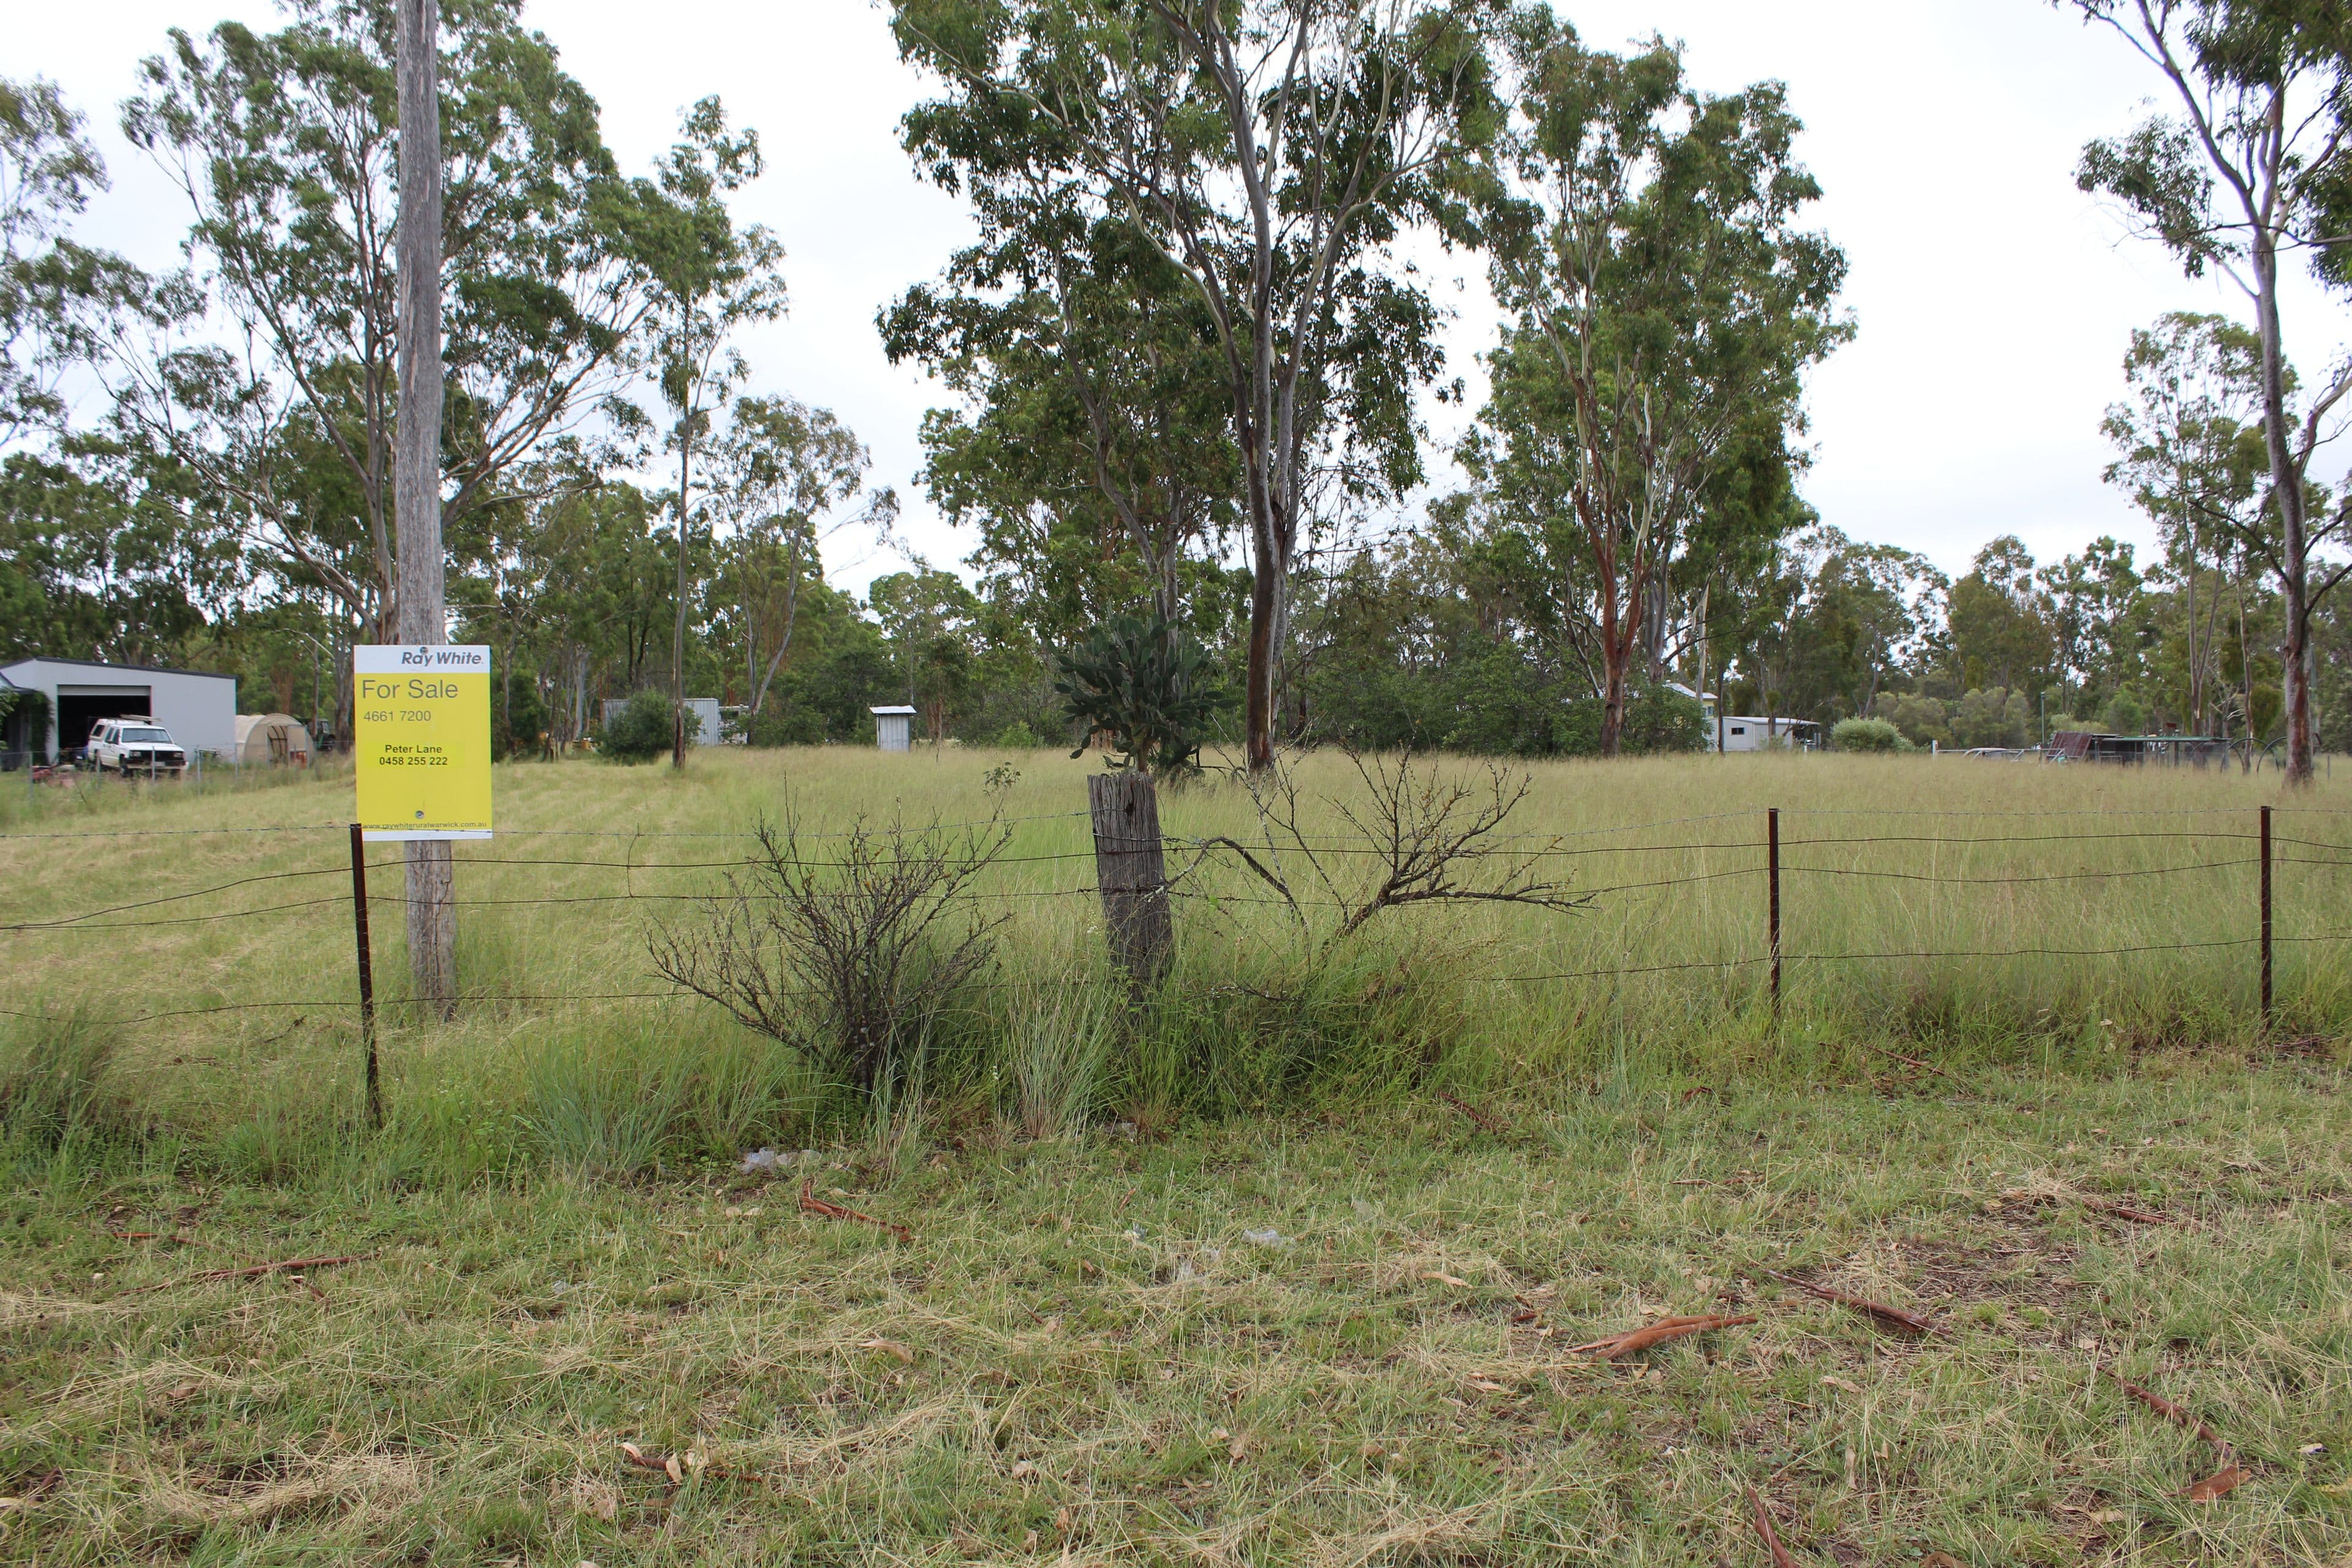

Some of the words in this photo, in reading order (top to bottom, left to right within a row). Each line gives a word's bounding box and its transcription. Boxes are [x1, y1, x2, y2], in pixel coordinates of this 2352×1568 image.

[402, 652, 433, 666] Ray
[437, 652, 481, 664] White
[363, 680, 400, 698] For
[408, 679, 458, 698] Sale
[363, 710, 393, 722] 4661
[399, 710, 431, 721] 7200
